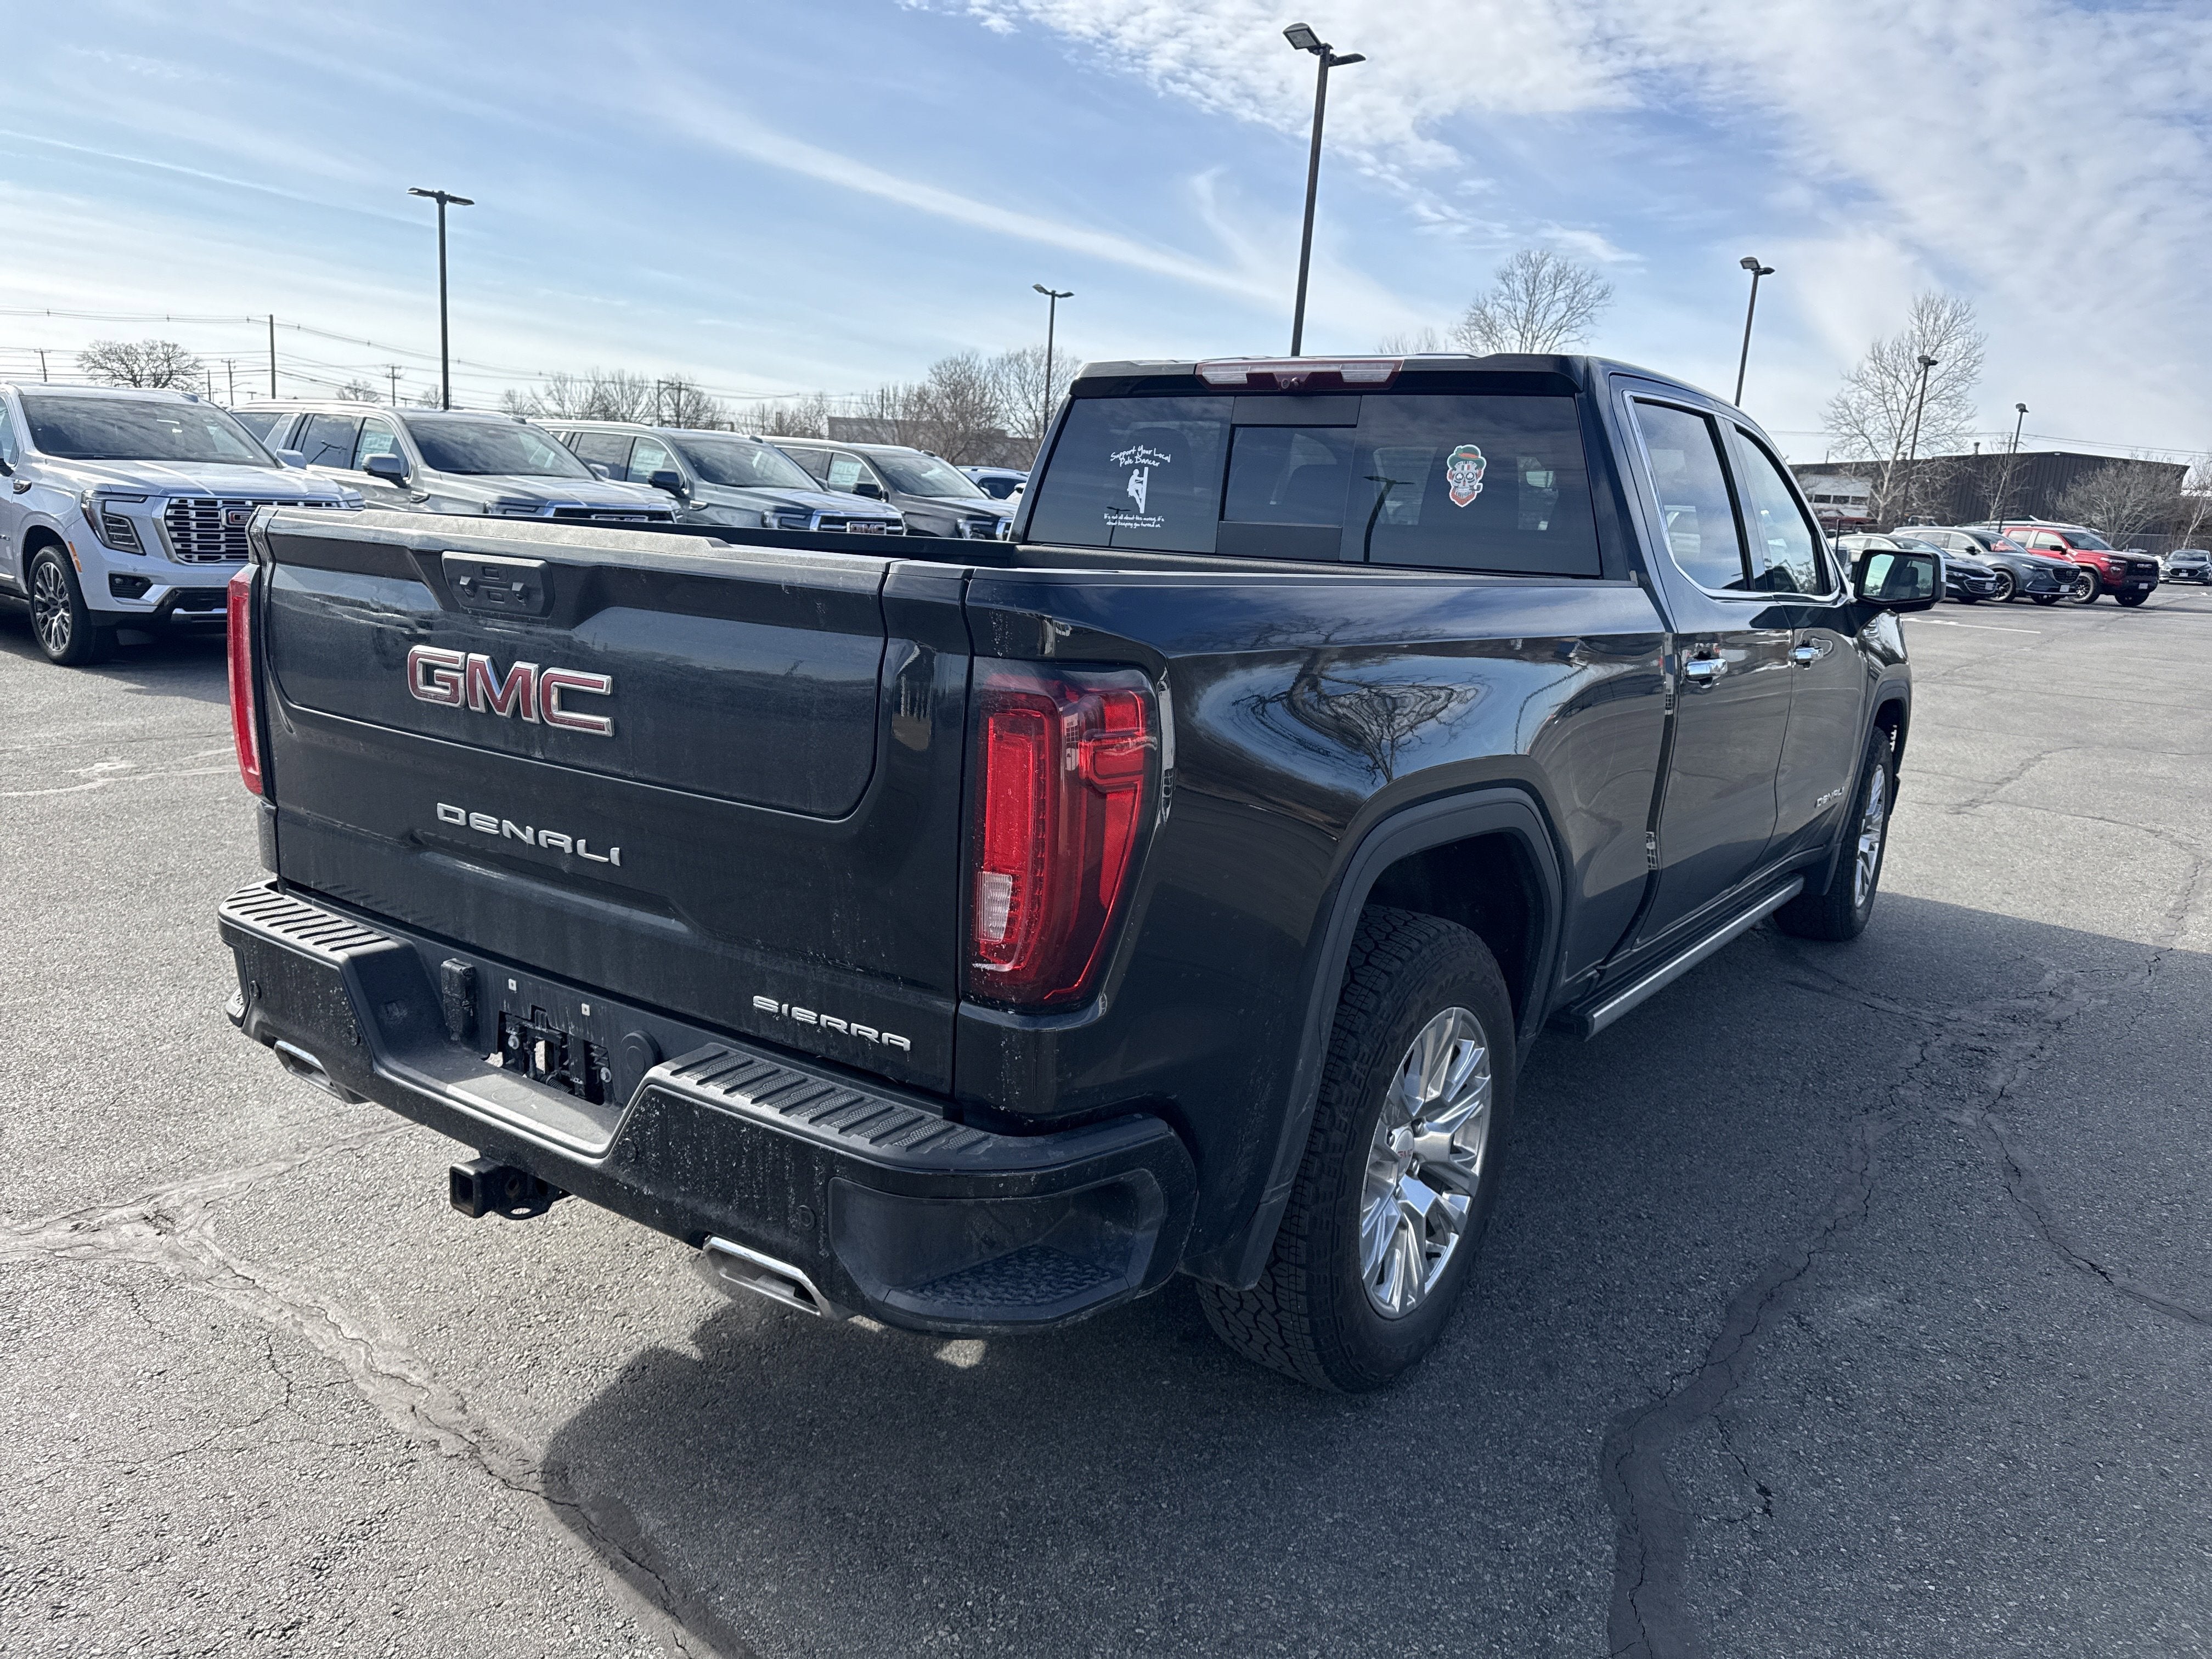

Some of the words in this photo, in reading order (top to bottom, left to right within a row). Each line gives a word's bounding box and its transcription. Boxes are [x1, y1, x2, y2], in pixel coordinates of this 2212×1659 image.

[1110, 445, 1136, 461] Support
[1137, 444, 1153, 458] Your
[1153, 447, 1171, 462] Local
[1119, 456, 1134, 467] Pole
[1135, 455, 1160, 467] Dancer
[408, 645, 615, 737] GMC
[1814, 786, 1844, 808] DENALI
[437, 803, 621, 866] DENALI
[753, 995, 911, 1051] SIERRA
